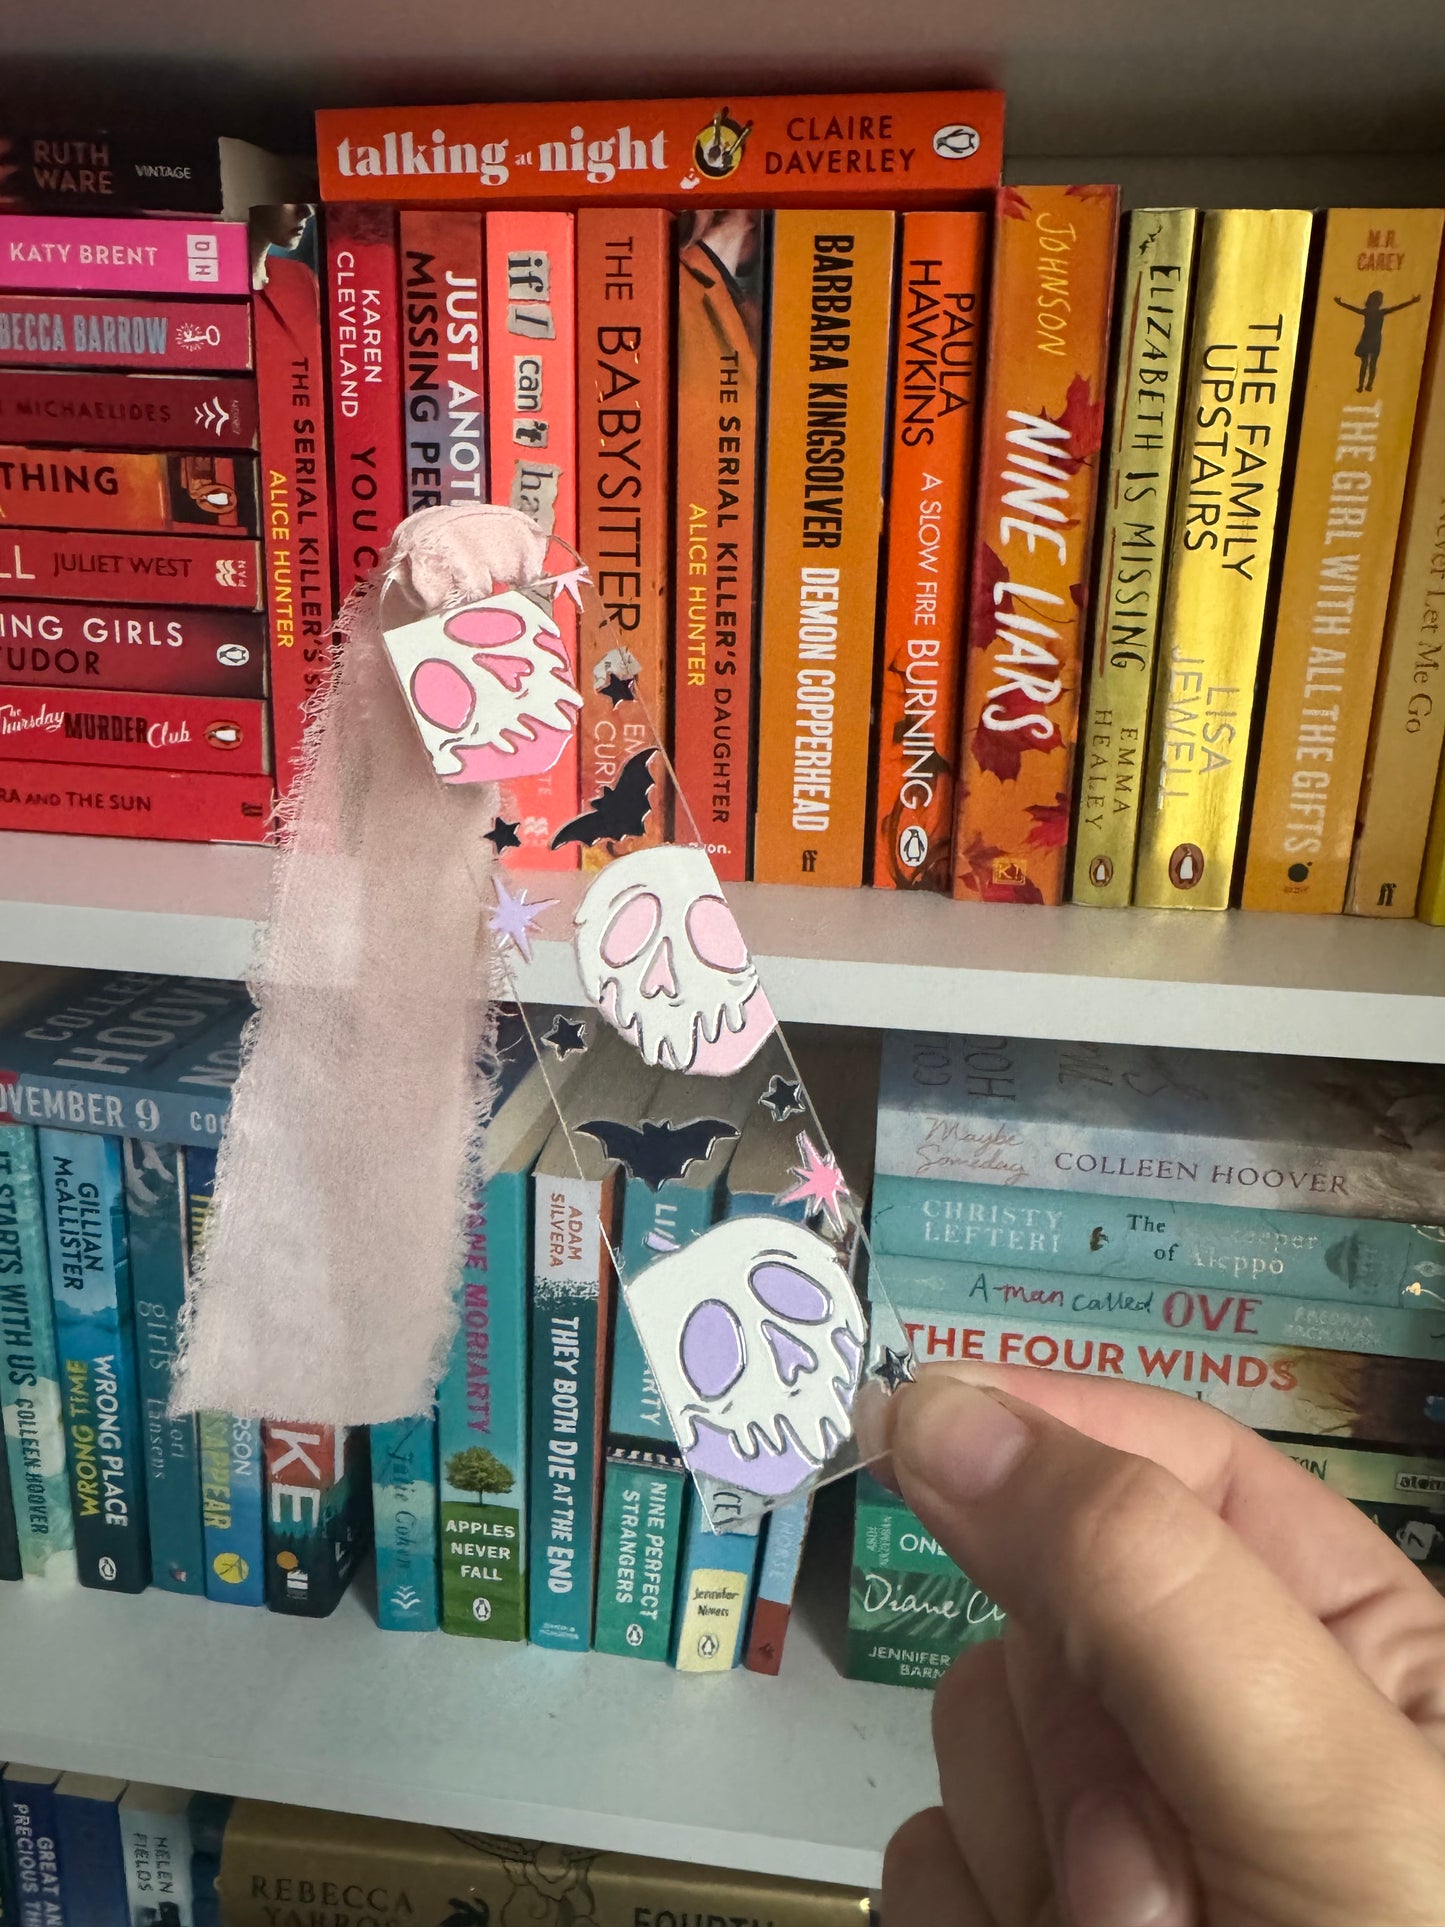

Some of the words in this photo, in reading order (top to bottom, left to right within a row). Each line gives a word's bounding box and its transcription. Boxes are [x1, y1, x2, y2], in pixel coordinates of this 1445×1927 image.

[32, 140, 110, 169] RUTH
[337, 128, 509, 187] talking
[514, 151, 533, 167] at
[538, 125, 670, 184] night
[786, 114, 894, 142] CLAIRE
[32, 166, 114, 195] WARE
[134, 165, 192, 180] VINTAGE
[765, 147, 917, 175] DAVERLEY
[10, 242, 71, 265] KATY
[79, 244, 158, 268] BRENT
[508, 255, 544, 293] if
[604, 235, 634, 301] THE
[1035, 212, 1077, 356] JOHNSON
[1356, 252, 1406, 271] CAREY
[73, 314, 169, 355] BARROW
[336, 250, 359, 418] CLEVELAND
[446, 270, 479, 372] JUST
[809, 234, 855, 373] BARBARA
[361, 288, 382, 385] KAREN
[405, 249, 439, 423] MISSING
[901, 259, 943, 447] HAWKINS
[935, 291, 976, 418] PAULA
[1131, 265, 1182, 452] ELIZABETH
[1239, 313, 1284, 406] THE
[290, 356, 310, 409] THE
[719, 351, 739, 404] THE
[15, 401, 172, 423] MICHAELIDES
[1334, 399, 1384, 462] THE
[0, 461, 119, 496] THING
[292, 418, 316, 526] SERIAL
[597, 325, 642, 632] BABYSITTER
[717, 416, 741, 528] SERIAL
[802, 382, 848, 549] KINGSOLVER
[1183, 344, 1239, 553] UPSTAIRS
[269, 470, 289, 541] ALICE
[350, 446, 378, 533] YOU
[920, 471, 943, 492] A
[999, 410, 1073, 567] NINE
[1123, 471, 1160, 503] IS
[1221, 424, 1273, 581] FAMILY
[1323, 469, 1373, 546] GIRL
[53, 551, 124, 578] JULIET
[129, 555, 193, 579] WEST
[688, 503, 708, 577] ALICE
[918, 500, 943, 574] SLOW
[273, 550, 294, 649] HUNTER
[297, 536, 323, 664] KILLER'S
[714, 542, 739, 676] KILLER'S
[798, 566, 840, 660] DEMON
[914, 582, 938, 627] FIRE
[1109, 521, 1158, 673] MISSING
[1311, 554, 1361, 636] WITH
[82, 616, 184, 648] GIRLS
[687, 585, 707, 688] HUNTER
[980, 581, 1065, 740] LIARS
[1412, 640, 1444, 684] Me
[1303, 646, 1347, 699] ALL
[64, 711, 148, 744] MURDER
[147, 720, 192, 748] Club
[900, 638, 941, 811] BURNING
[1158, 645, 1206, 811] JEWELL
[1199, 686, 1241, 776] LISA
[1294, 704, 1340, 763] THE
[1405, 692, 1433, 735] Go
[712, 688, 733, 824] DAUGHTER
[792, 668, 836, 832] COPPERHEAD
[1083, 709, 1114, 831] HEALEY
[1112, 727, 1139, 815] EMMA
[25, 791, 61, 807] AND
[65, 790, 105, 809] THE
[109, 793, 151, 812] SUN
[1283, 769, 1332, 855] GIFTS
[135, 1098, 160, 1132] 9
[926, 1117, 1024, 1150] Maybe
[915, 1143, 1030, 1186] Someday
[1054, 1152, 1199, 1181] COLLEEN
[1210, 1164, 1350, 1197] HOOVER
[53, 1155, 84, 1292] McALLISTER
[78, 1182, 104, 1272] GILLIAN
[549, 1191, 566, 1268] SILVERA
[567, 1205, 584, 1262] ADAM
[921, 1200, 1064, 1229] CHRISTY
[923, 1221, 1061, 1254] LEFTERI
[1125, 1213, 1167, 1234] The
[1153, 1242, 1180, 1262] of
[0, 1284, 33, 1347] WITH
[968, 1272, 989, 1303] A
[992, 1283, 1065, 1308] man
[1071, 1291, 1154, 1315] called
[1162, 1290, 1262, 1335] OVE
[7, 1353, 37, 1387] US
[464, 1284, 491, 1434] MORIARTY
[550, 1316, 580, 1377] THEY
[901, 1322, 987, 1361] THE
[999, 1332, 1125, 1375] FOUR
[1137, 1345, 1298, 1391] WINDS
[92, 1353, 122, 1451] WRONG
[551, 1379, 580, 1434] BOTH
[15, 1398, 42, 1472] COLLEEN
[547, 1439, 578, 1481] DIE
[72, 1423, 102, 1518] WRONG
[101, 1453, 130, 1528] PLACE
[552, 1483, 574, 1506] AT
[25, 1471, 50, 1536] HOOVER
[445, 1519, 516, 1540] APPLES
[550, 1506, 575, 1542] THE
[646, 1481, 668, 1530] NINE
[450, 1542, 511, 1561] NEVER
[460, 1565, 503, 1582] FALL
[546, 1546, 575, 1594] END
[615, 1488, 641, 1604] STRANGERS
[639, 1530, 666, 1622] PERFECT
[863, 1573, 962, 1618] Diane
[868, 1646, 951, 1666] JENNIFER
[12, 1802, 40, 1894] PRECIOUS
[36, 1836, 60, 1897] GREAT
[133, 1832, 154, 1892] FIELDS
[152, 1836, 174, 1895] HELEN
[251, 1875, 415, 1915] REBECCA
